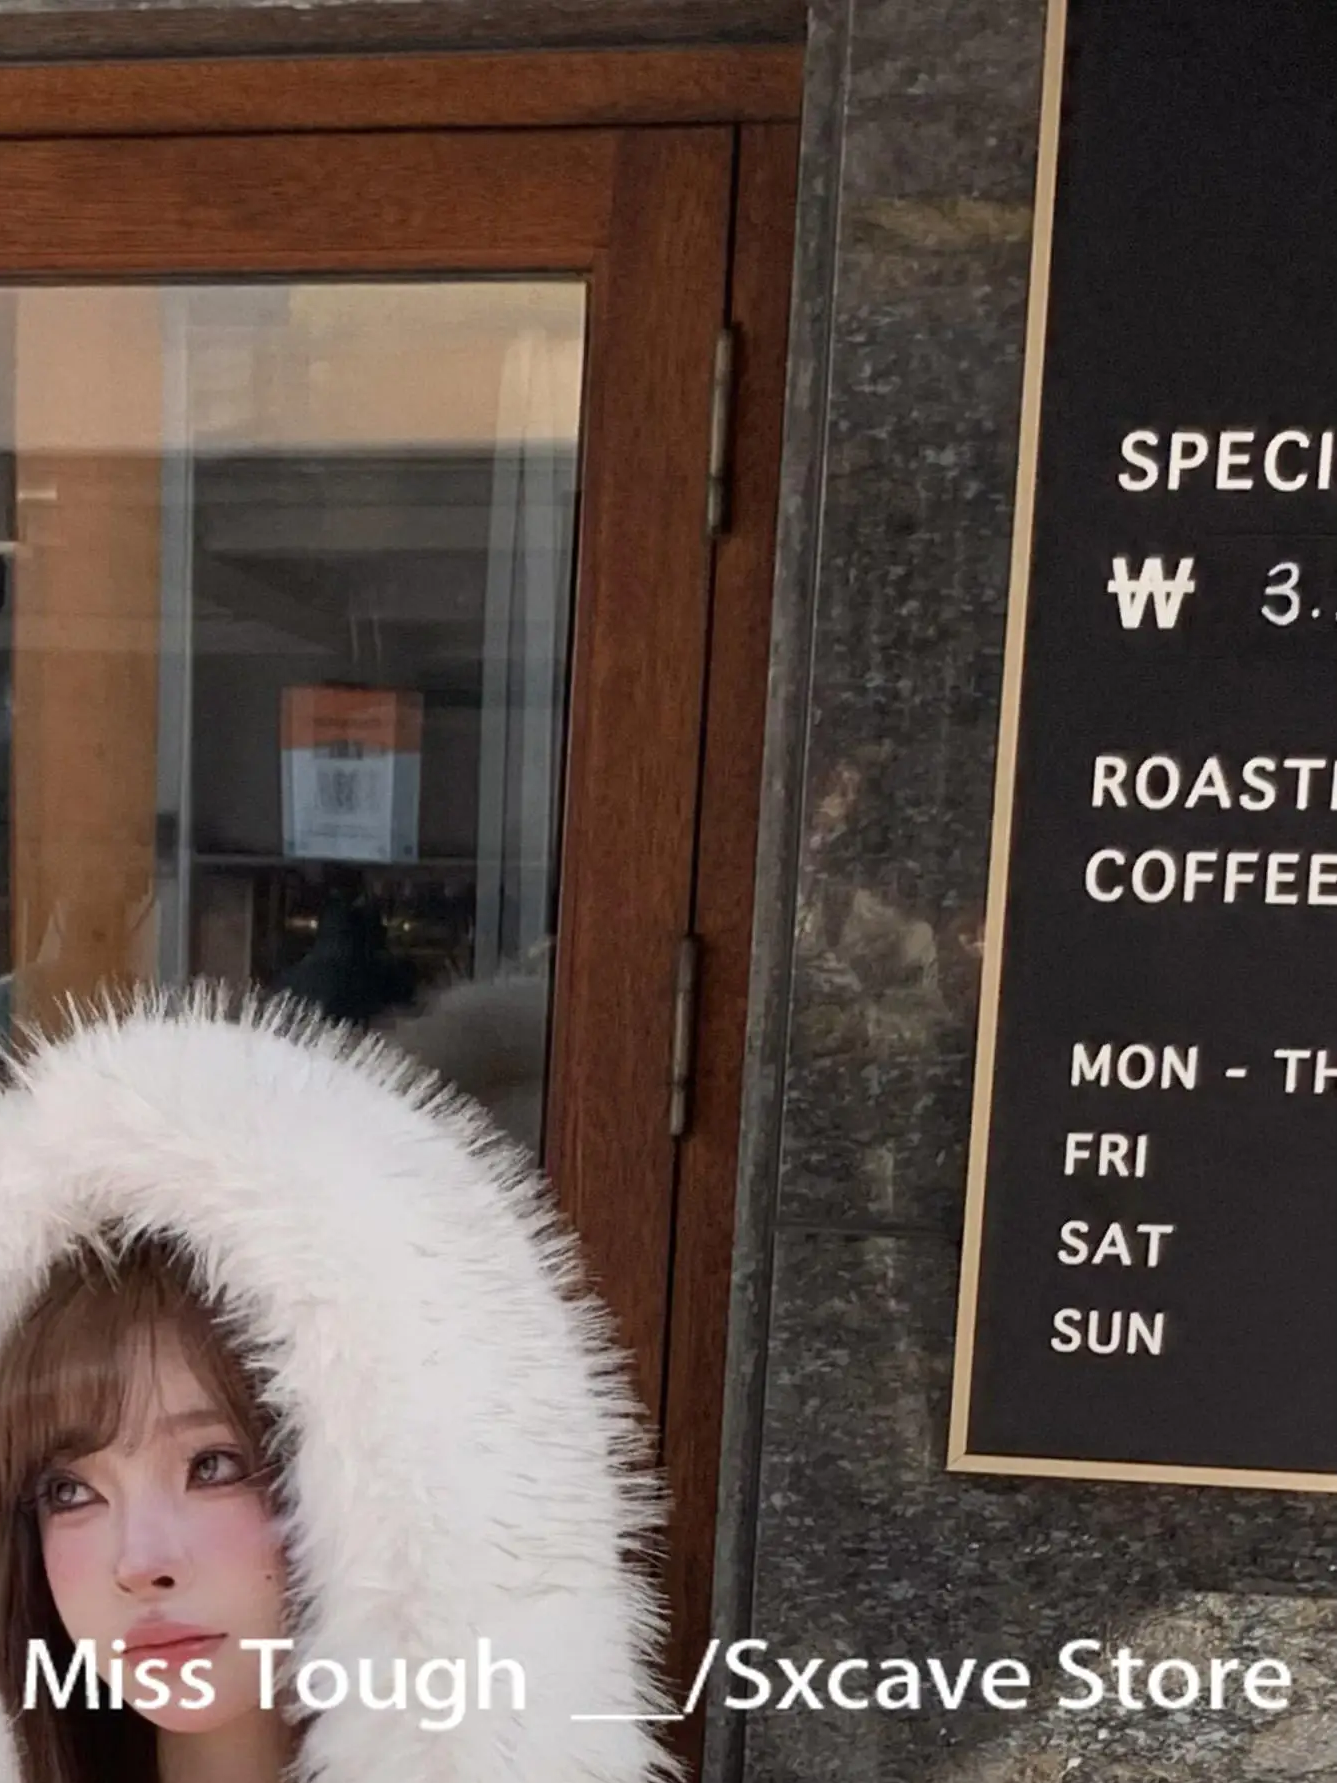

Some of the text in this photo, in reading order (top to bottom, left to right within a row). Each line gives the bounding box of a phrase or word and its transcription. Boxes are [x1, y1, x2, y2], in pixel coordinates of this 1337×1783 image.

[1090, 755, 1337, 811] ROAST
[1084, 848, 1337, 905] COFFEE
[1070, 1043, 1199, 1090] MON
[1225, 1067, 1248, 1079] -
[1063, 1132, 1149, 1178] FRI
[1056, 1220, 1175, 1268] SAT
[1050, 1308, 1164, 1356] SUN
